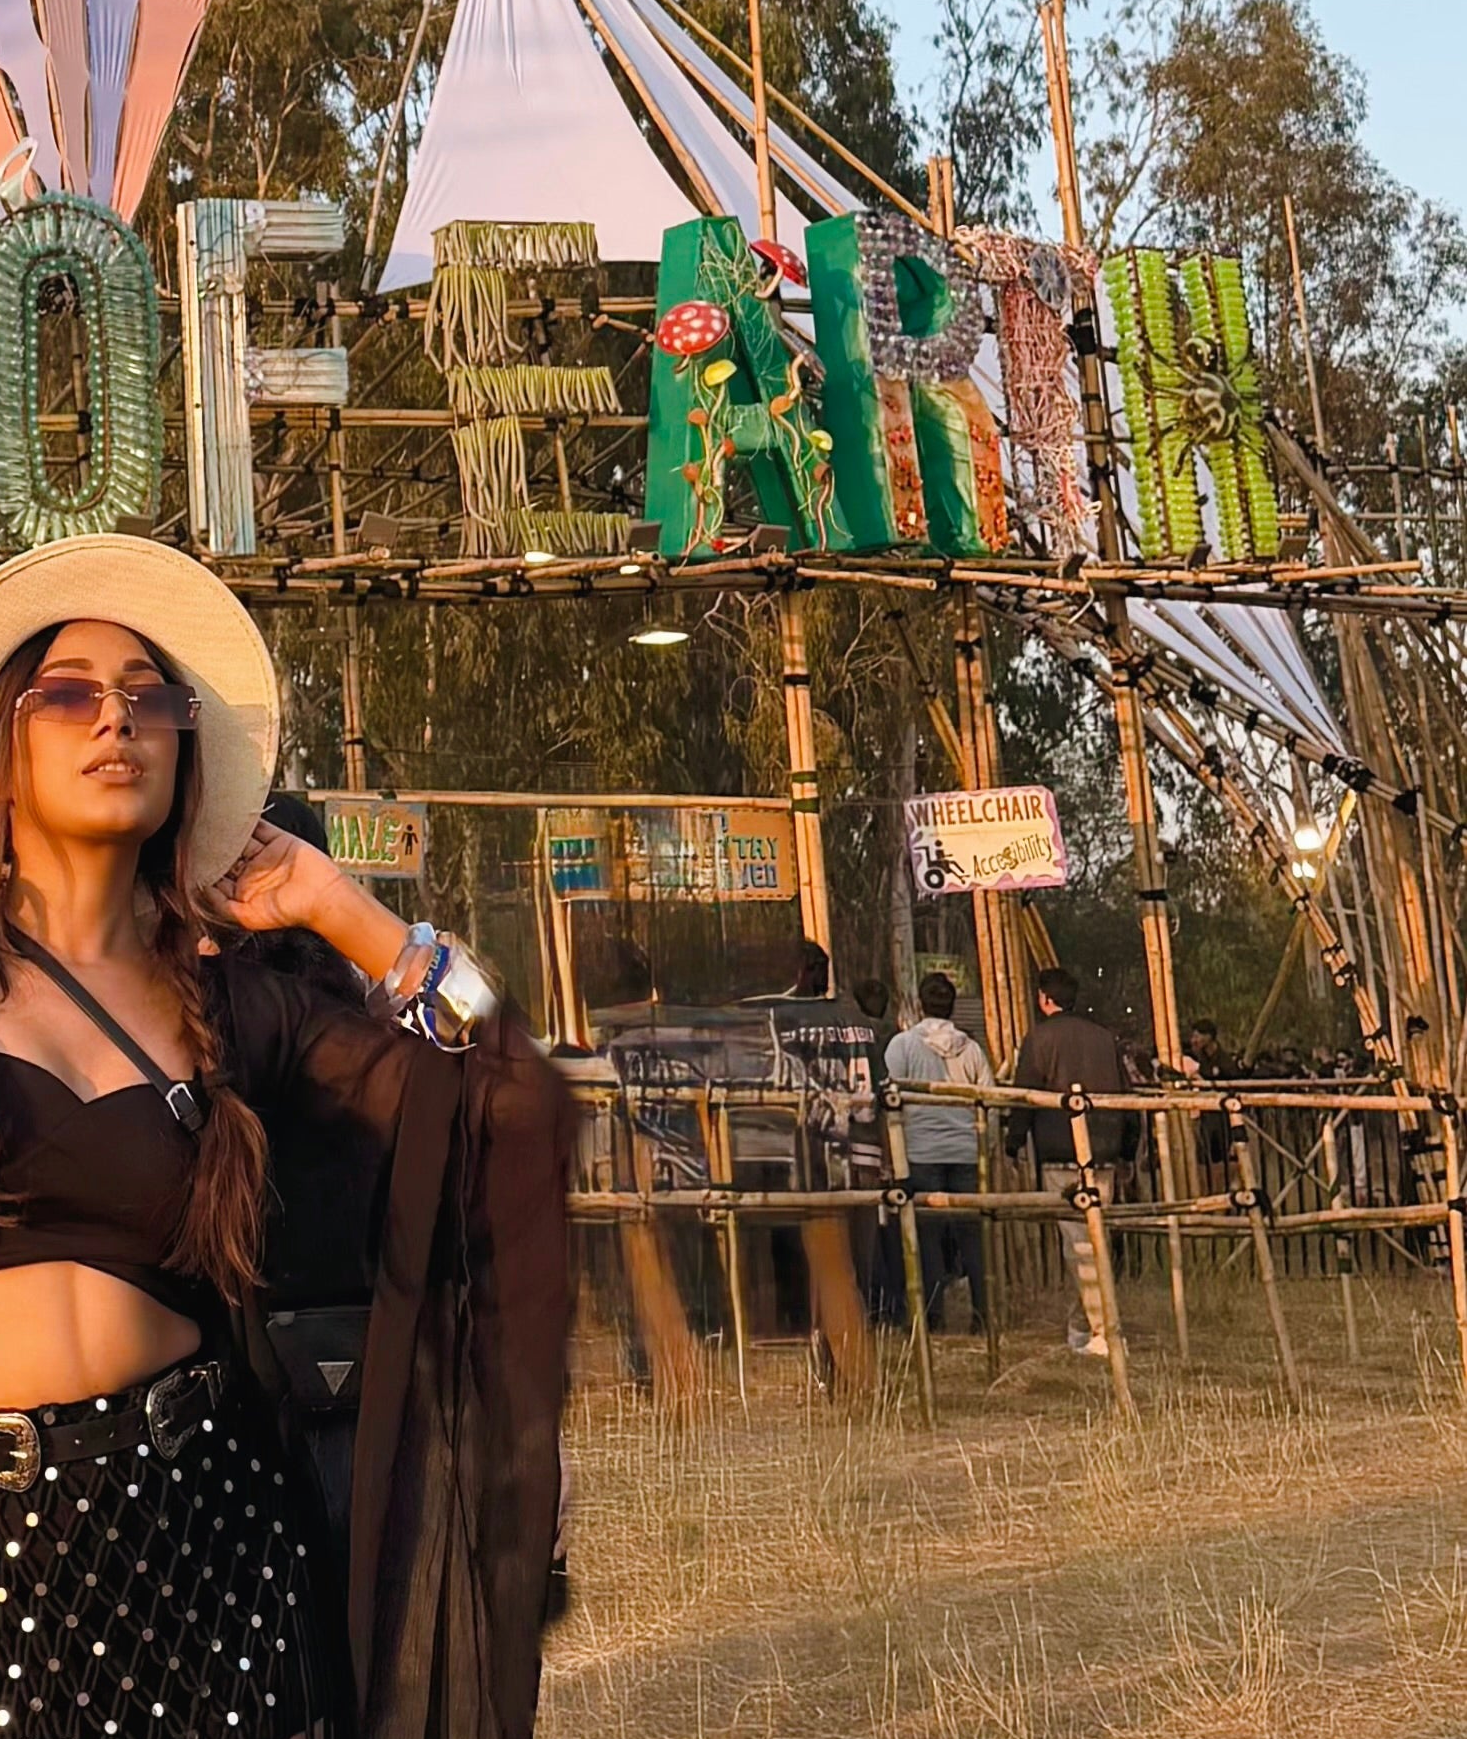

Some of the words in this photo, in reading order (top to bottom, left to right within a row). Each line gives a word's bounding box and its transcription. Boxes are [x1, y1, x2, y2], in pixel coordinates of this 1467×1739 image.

[422, 210, 1279, 562] EARTH
[909, 795, 1044, 827] WHEELCHAIR
[330, 815, 403, 864] MALE
